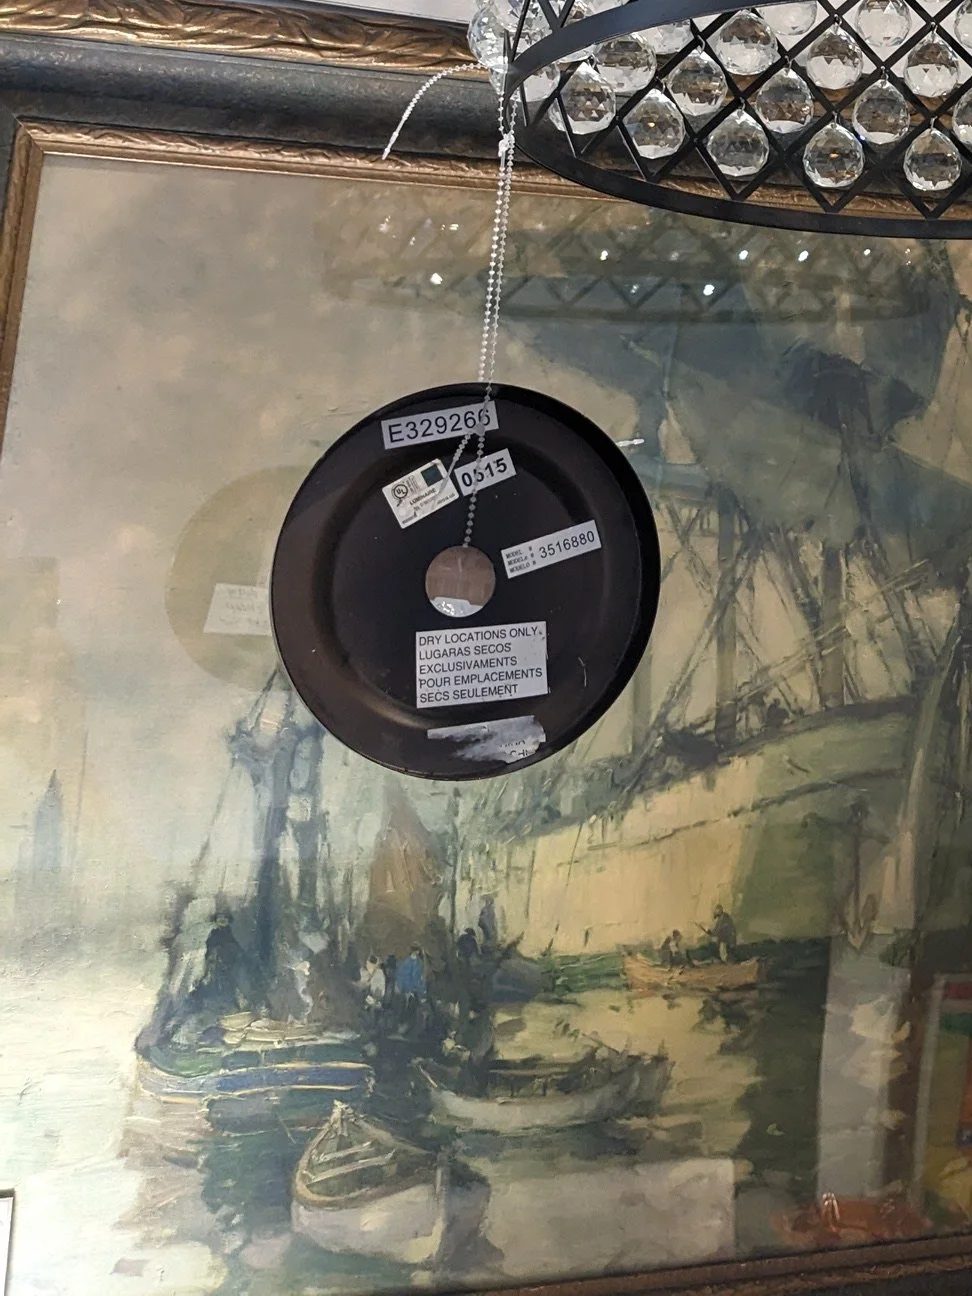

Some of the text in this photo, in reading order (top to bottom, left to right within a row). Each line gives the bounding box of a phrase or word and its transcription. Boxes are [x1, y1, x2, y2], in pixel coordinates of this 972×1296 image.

[388, 408, 491, 443] E329266
[539, 530, 595, 559] 3516880
[419, 626, 538, 646] DRY LOCATIONS ONLY
[419, 642, 512, 660] LUGARAS SECOS
[419, 656, 518, 674] EXCLUSIVAMENTS
[419, 667, 543, 689] POUR EMPLACEMENTS
[420, 684, 519, 703] SECS SEULEMENT
